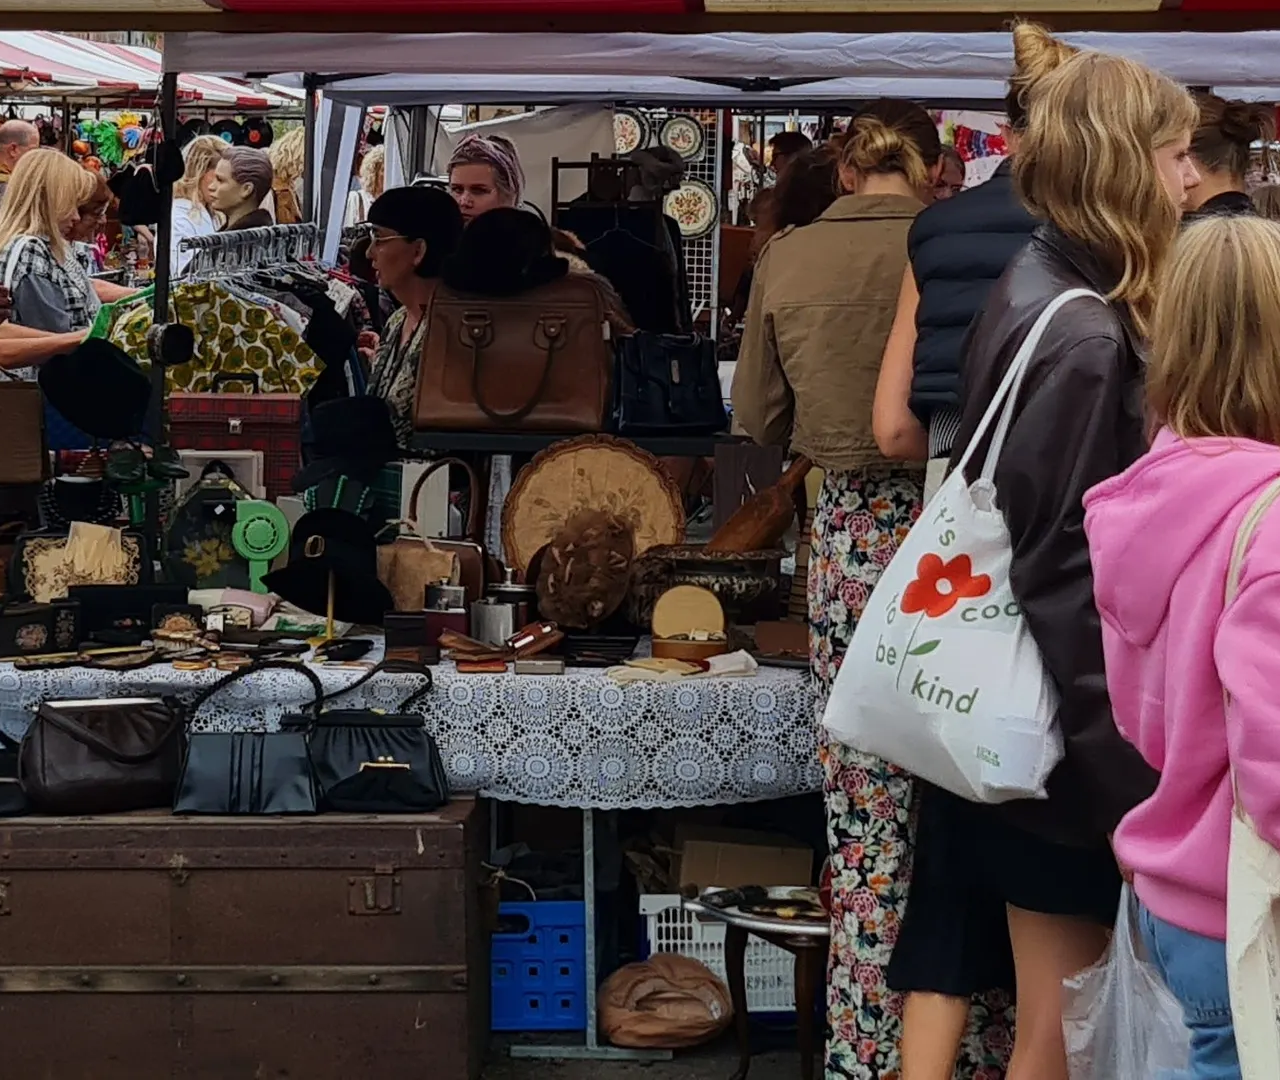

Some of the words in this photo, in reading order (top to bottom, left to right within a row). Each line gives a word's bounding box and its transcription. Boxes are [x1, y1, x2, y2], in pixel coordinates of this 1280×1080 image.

[960, 602, 1021, 622] coo
[876, 634, 897, 666] be
[911, 669, 979, 715] kind
